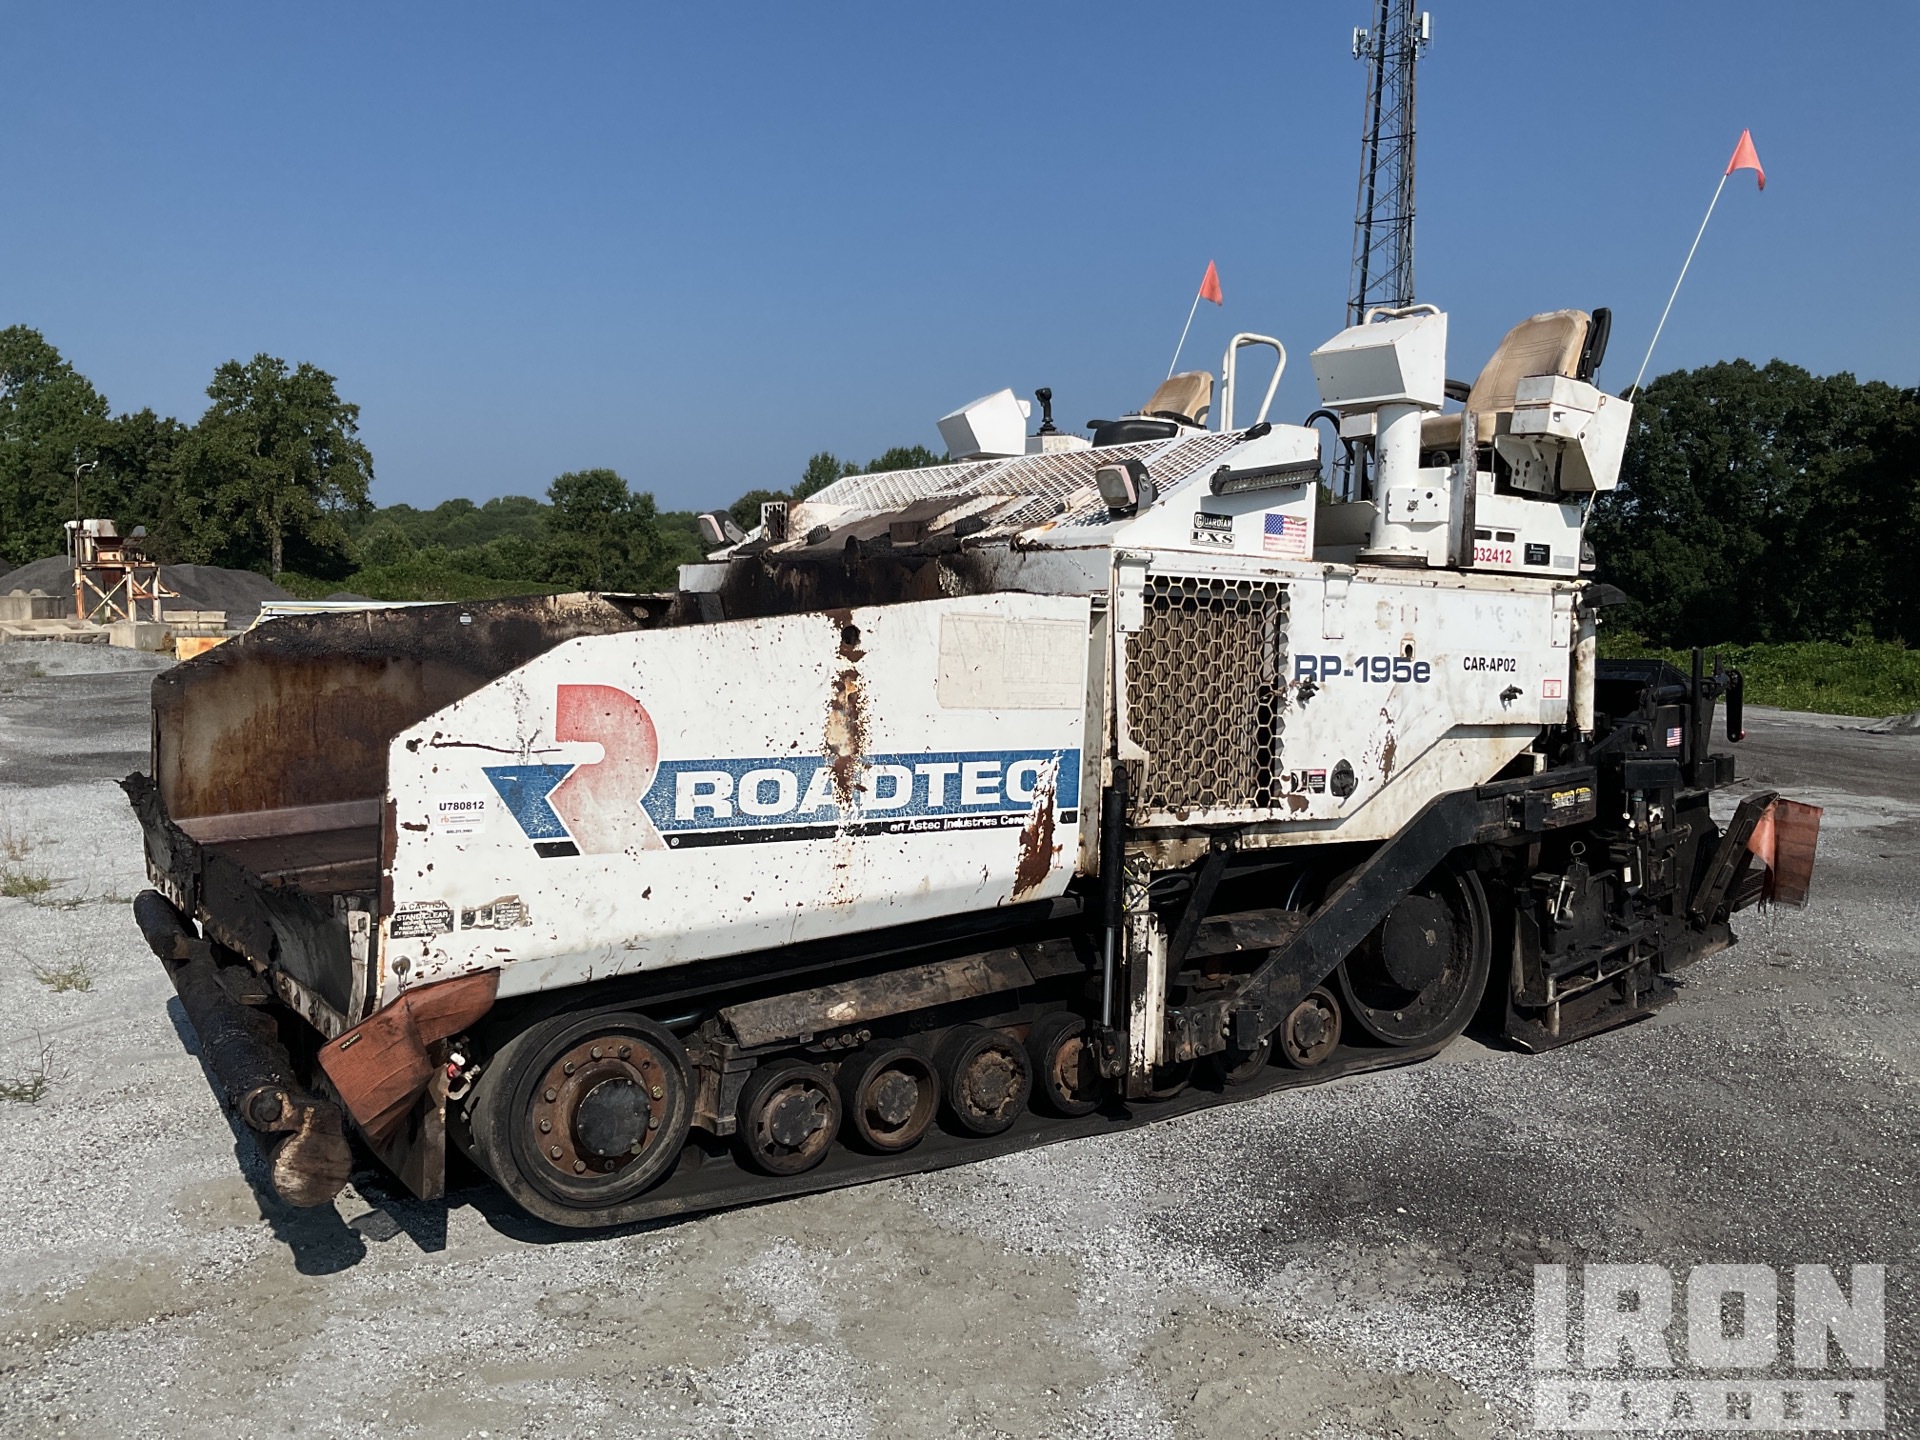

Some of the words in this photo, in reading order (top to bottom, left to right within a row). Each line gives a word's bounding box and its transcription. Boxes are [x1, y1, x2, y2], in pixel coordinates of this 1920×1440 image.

[1195, 514, 1232, 529] GUARDIAN
[1193, 531, 1233, 544] FXS
[1294, 654, 1431, 683] RP-195e
[1463, 656, 1516, 673] CAR-AP02
[674, 758, 1051, 821] ROADTEC
[439, 801, 485, 811] U780812
[908, 819, 941, 831] Astec
[944, 816, 998, 830] Industries
[396, 914, 422, 922] STAND
[423, 911, 448, 919] CLEAR
